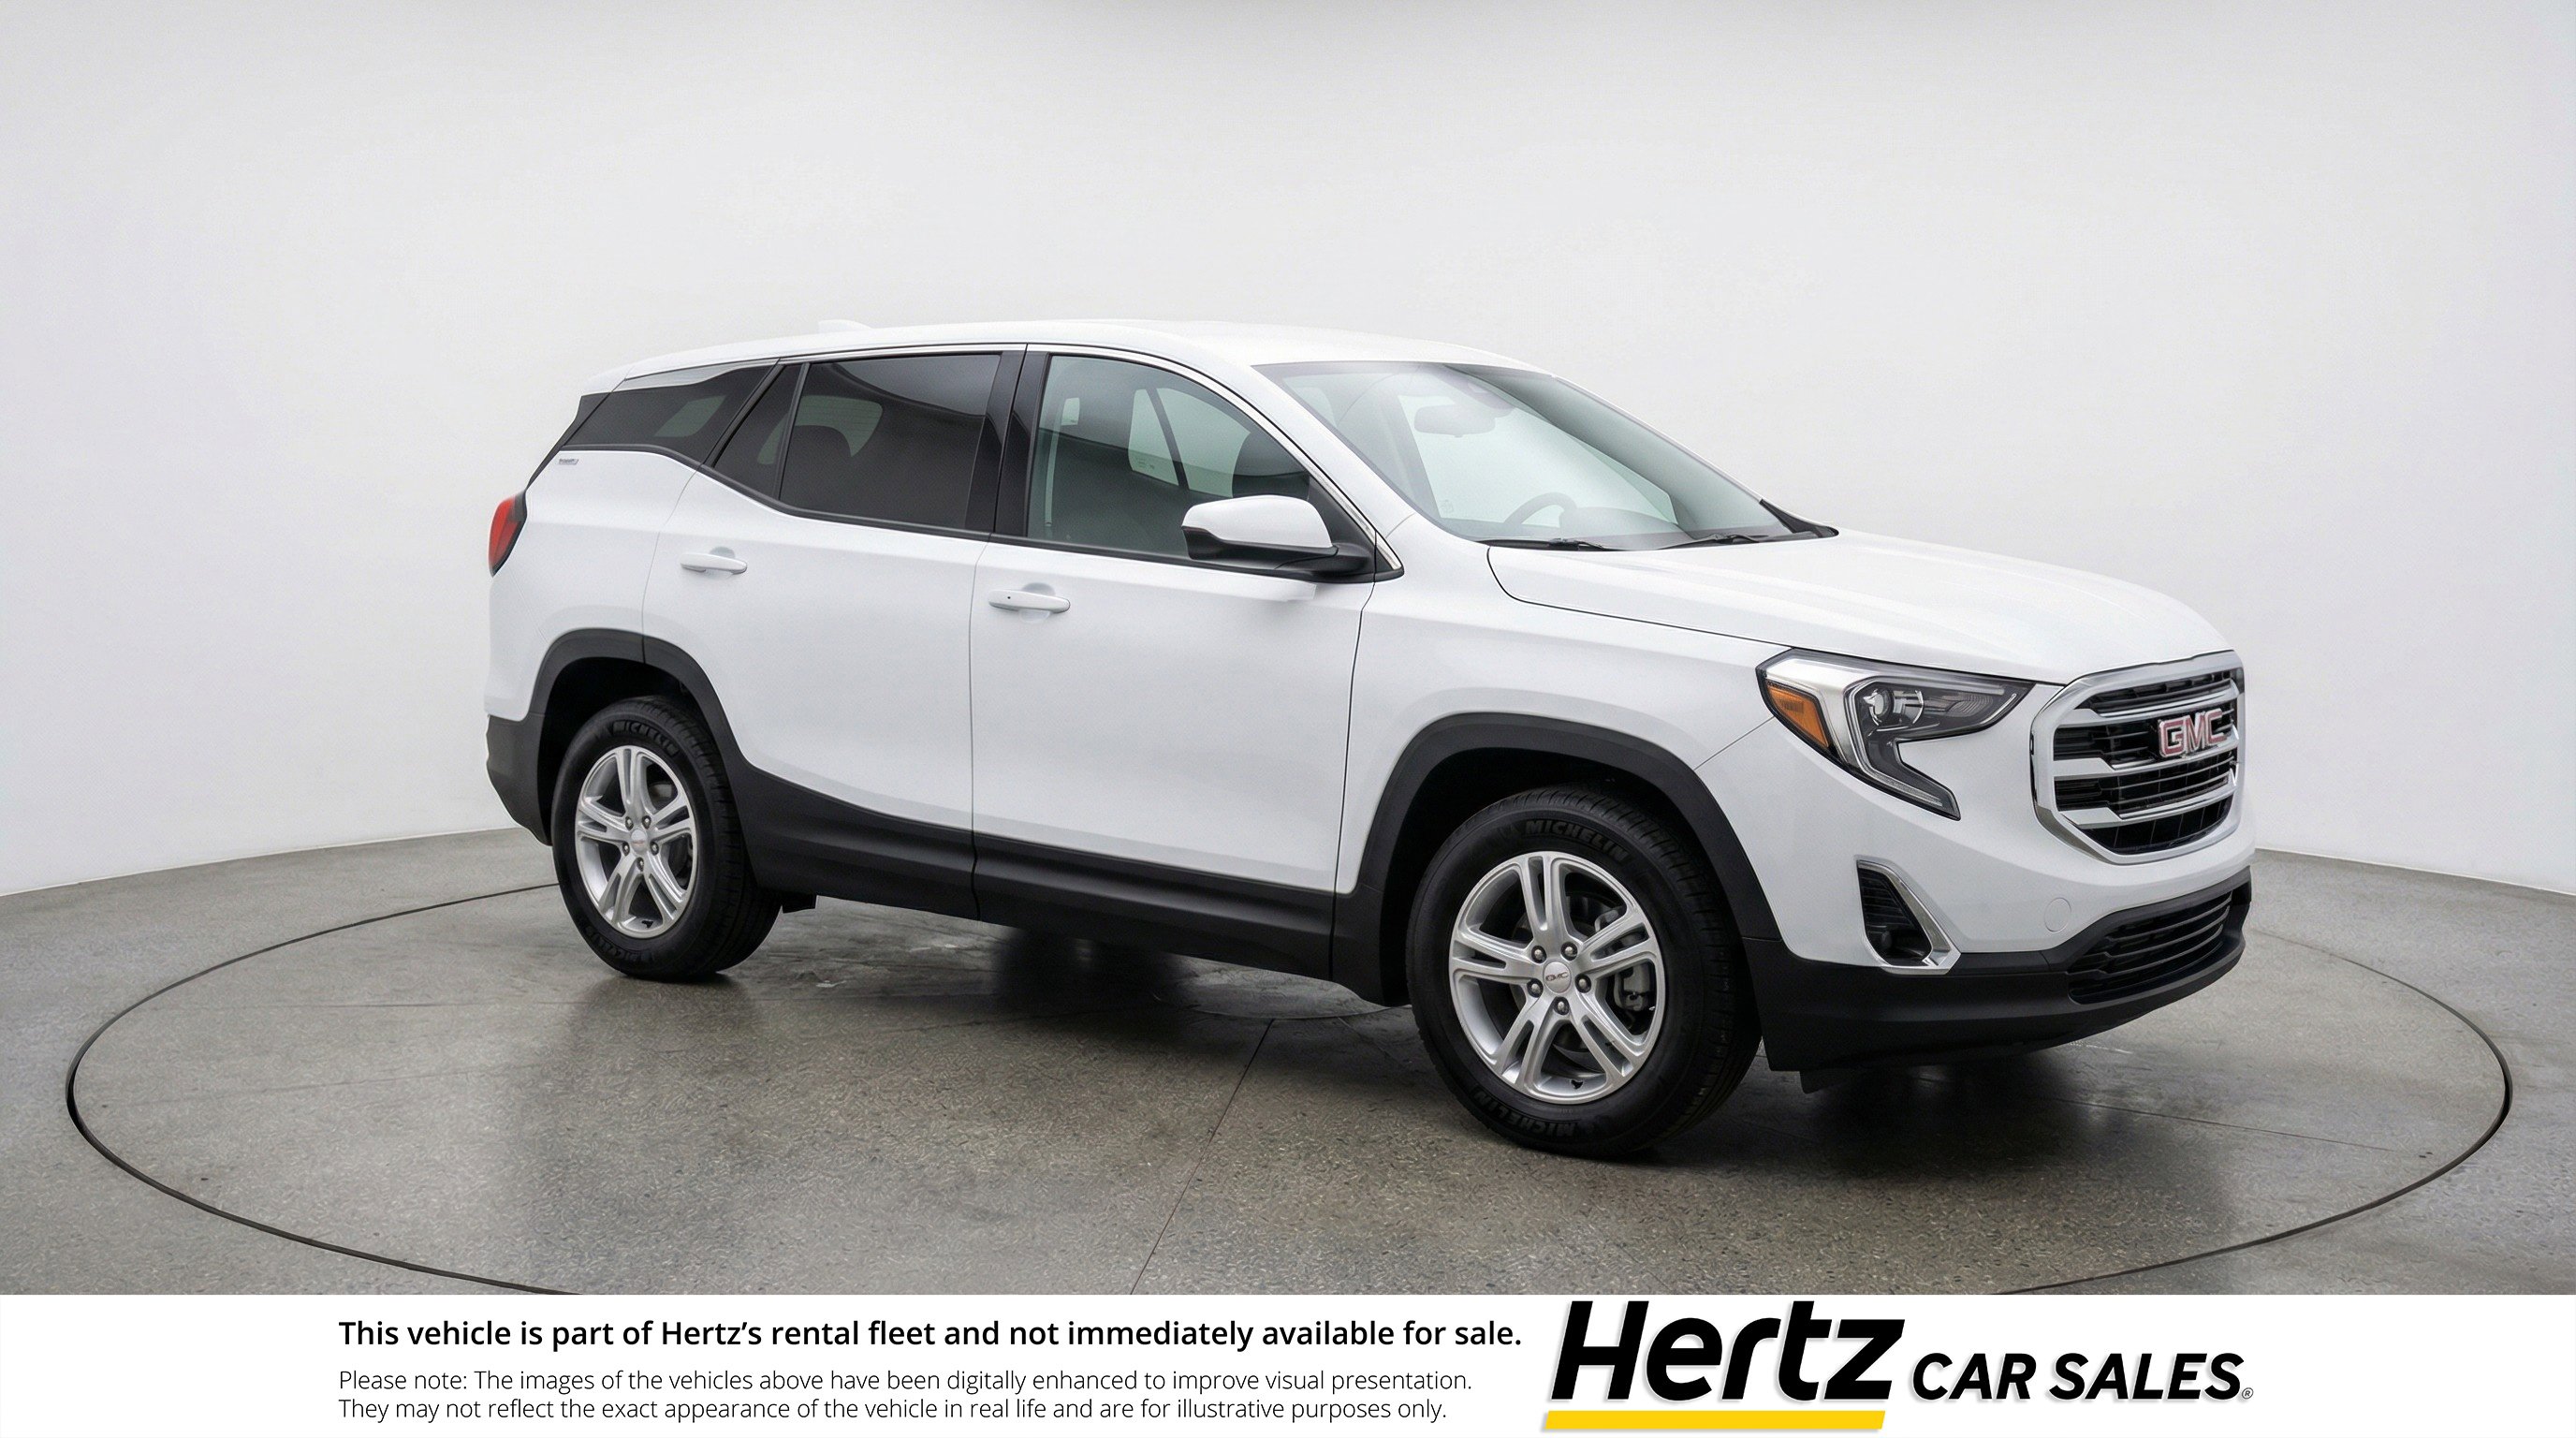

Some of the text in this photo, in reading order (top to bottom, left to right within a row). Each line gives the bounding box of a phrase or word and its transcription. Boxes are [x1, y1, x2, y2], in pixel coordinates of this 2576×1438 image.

[2159, 709, 2227, 757] GMC
[1525, 818, 1631, 862] MICHELIN
[1471, 1085, 1576, 1138] MICHELIN
